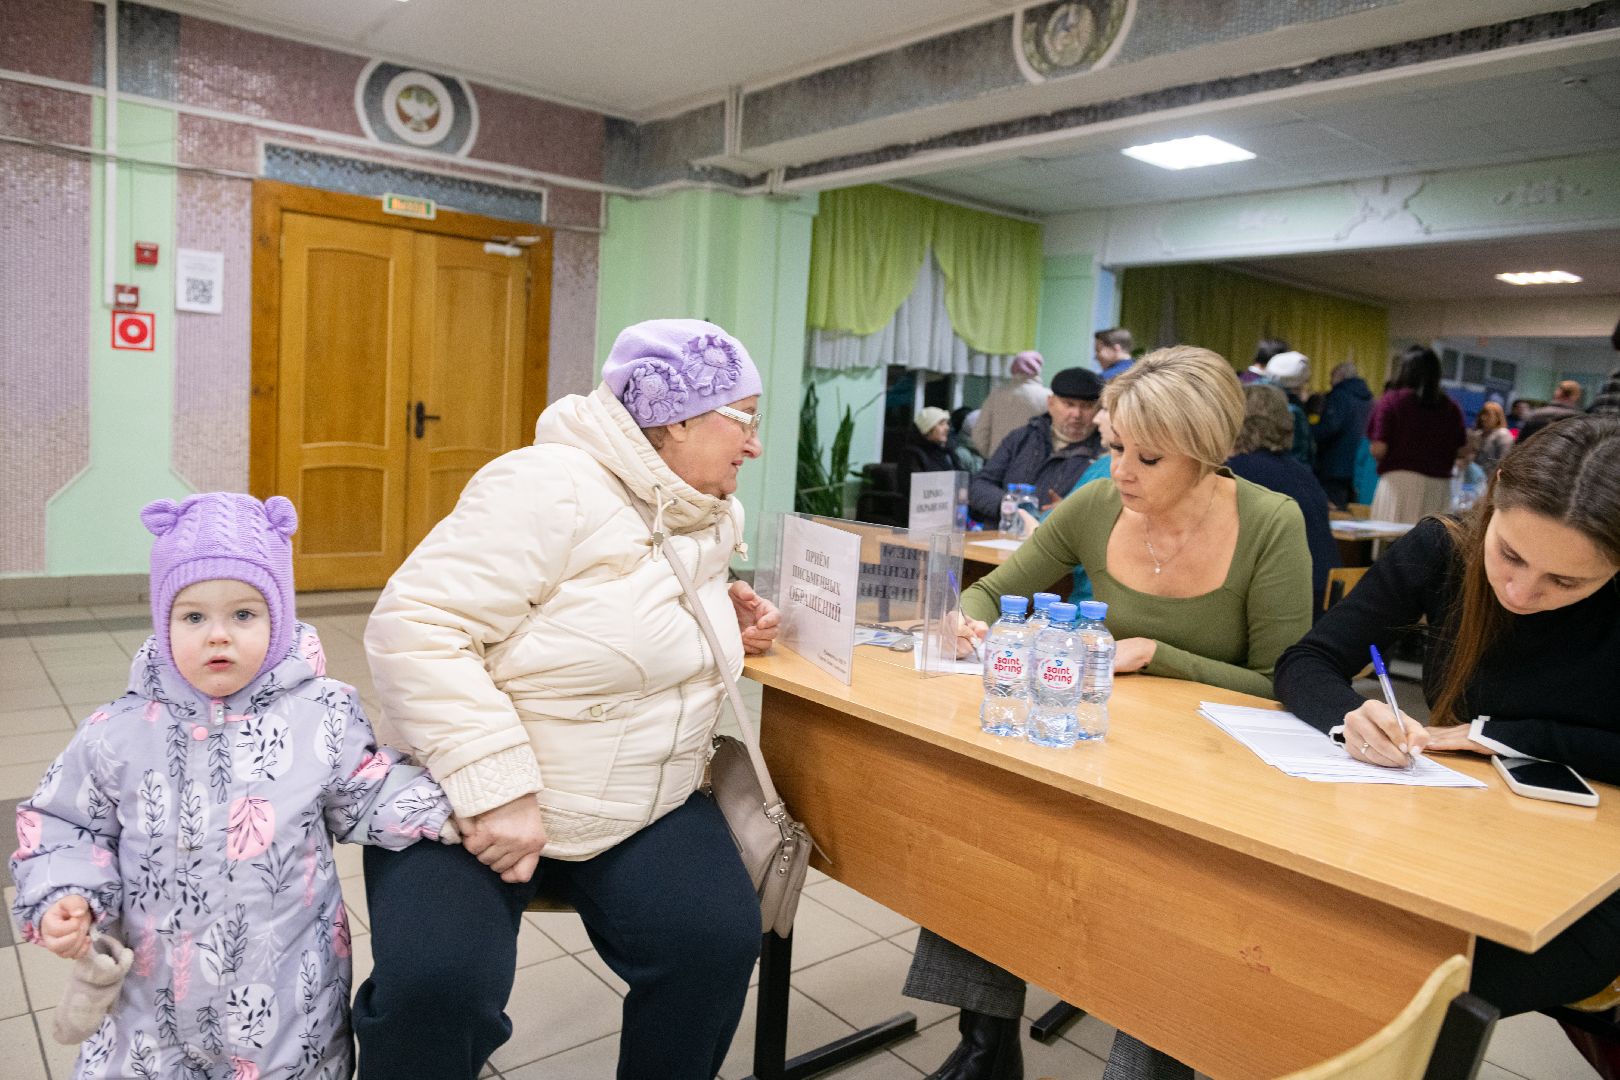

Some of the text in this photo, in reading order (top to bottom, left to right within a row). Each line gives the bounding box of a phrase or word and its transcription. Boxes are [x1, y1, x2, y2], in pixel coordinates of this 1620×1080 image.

[805, 548, 830, 569] ПРИЁМ
[792, 564, 841, 596] ПИСЬМЕННЫХ
[789, 585, 841, 622] ОБРАЩЕНИЙ
[997, 656, 1020, 665] saint
[994, 663, 1021, 674] spring
[1047, 666, 1070, 675] saint
[1044, 673, 1072, 684] spring
